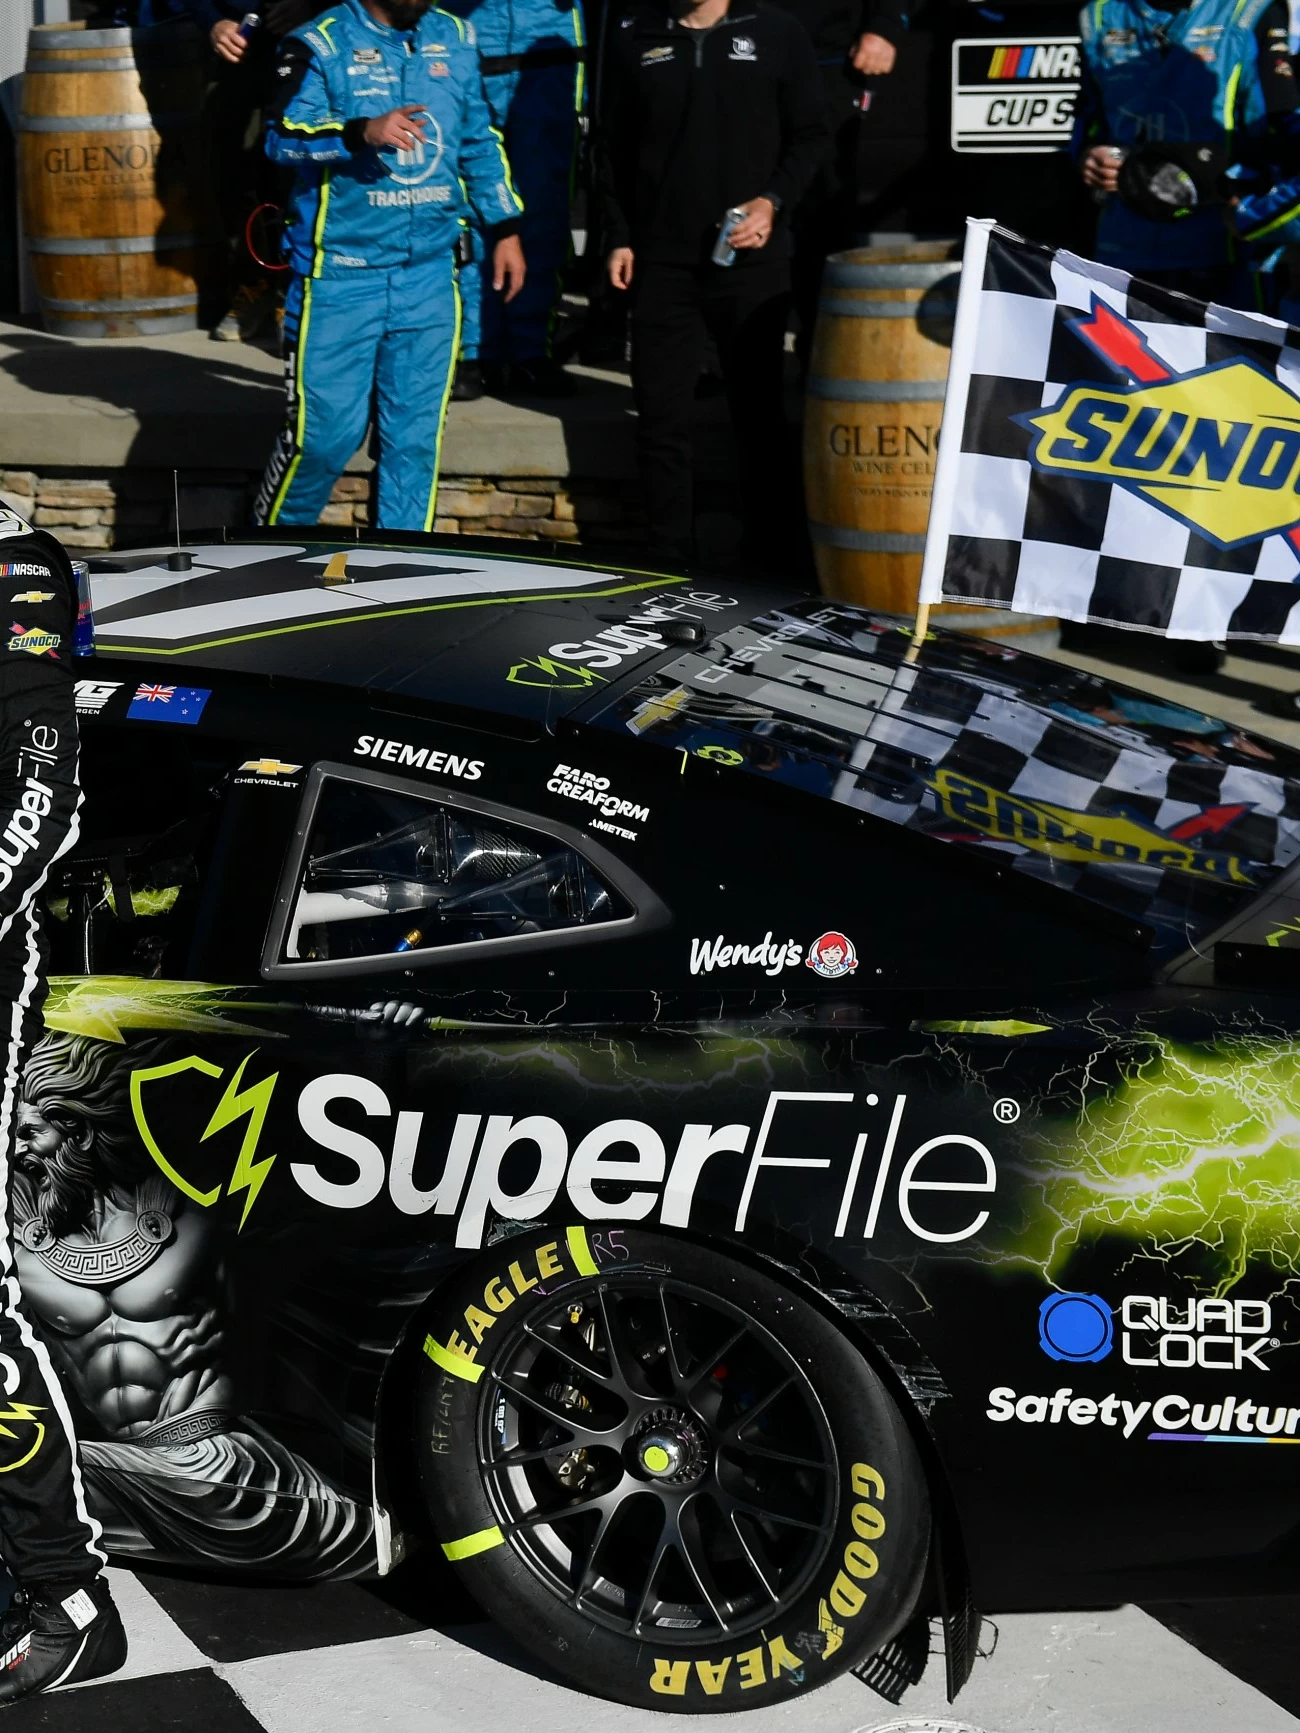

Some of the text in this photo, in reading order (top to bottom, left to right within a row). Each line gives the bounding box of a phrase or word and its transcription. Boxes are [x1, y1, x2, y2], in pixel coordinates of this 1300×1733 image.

[987, 99, 1048, 126] CUP
[366, 186, 451, 207] TRACKHOUSE
[830, 424, 942, 456] GLEN
[1048, 397, 1300, 496] SUNO
[13, 563, 51, 577] NASCAR
[11, 635, 60, 649] SUNOCO
[694, 607, 846, 684] CHEVROLET
[353, 735, 486, 780] SIEMENS
[552, 763, 611, 791] FARO
[233, 777, 299, 788] CHEVROLET
[546, 778, 650, 823] CREAFORM
[588, 818, 638, 842] AMETEK
[689, 930, 803, 976] Wendy's
[290, 1072, 997, 1250] SuperFile
[445, 1240, 566, 1364] EAGLE
[1122, 1295, 1271, 1334] QUAD
[1122, 1332, 1271, 1371] LOCK
[986, 1387, 1300, 1439] SafetyCultur
